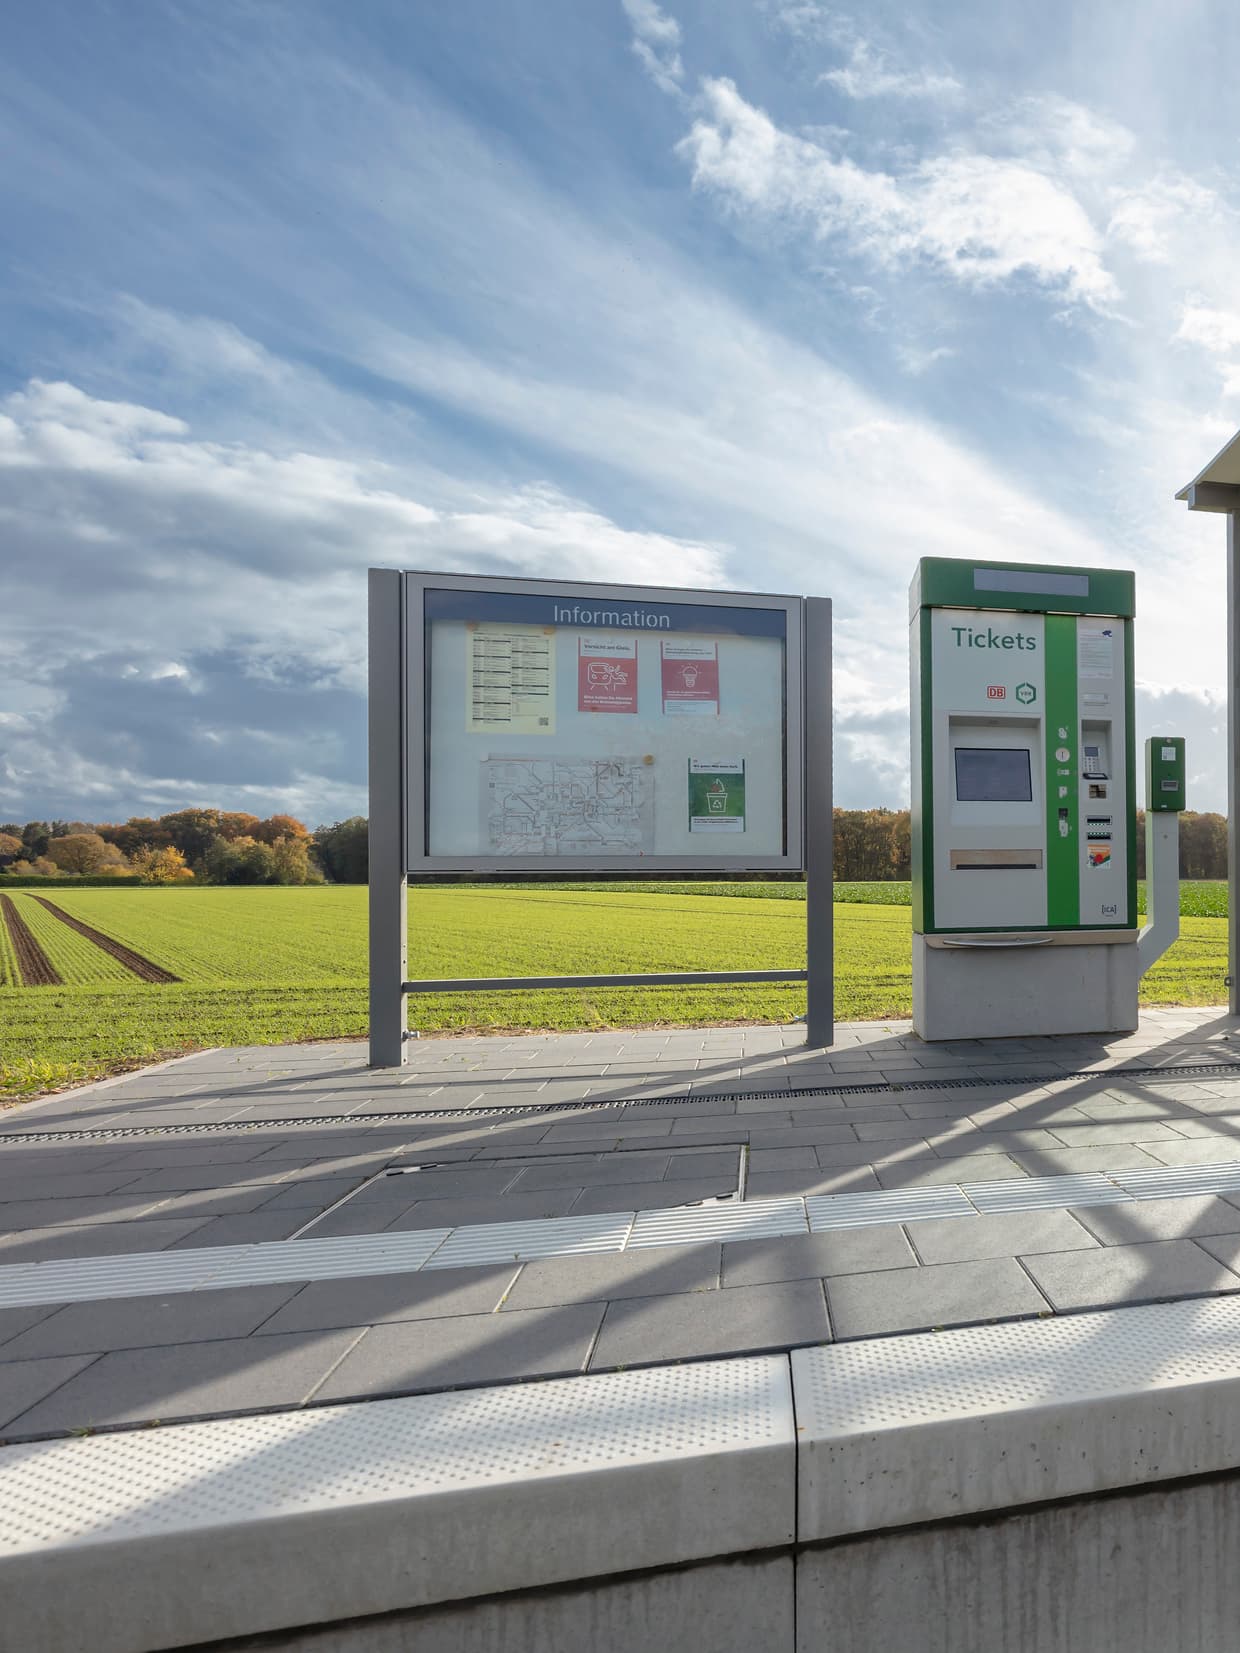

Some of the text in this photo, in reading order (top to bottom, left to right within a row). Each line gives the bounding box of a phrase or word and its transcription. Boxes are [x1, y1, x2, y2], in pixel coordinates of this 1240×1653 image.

[554, 605, 670, 628] Information
[951, 627, 1037, 651] Tickets
[989, 688, 1004, 697] DB
